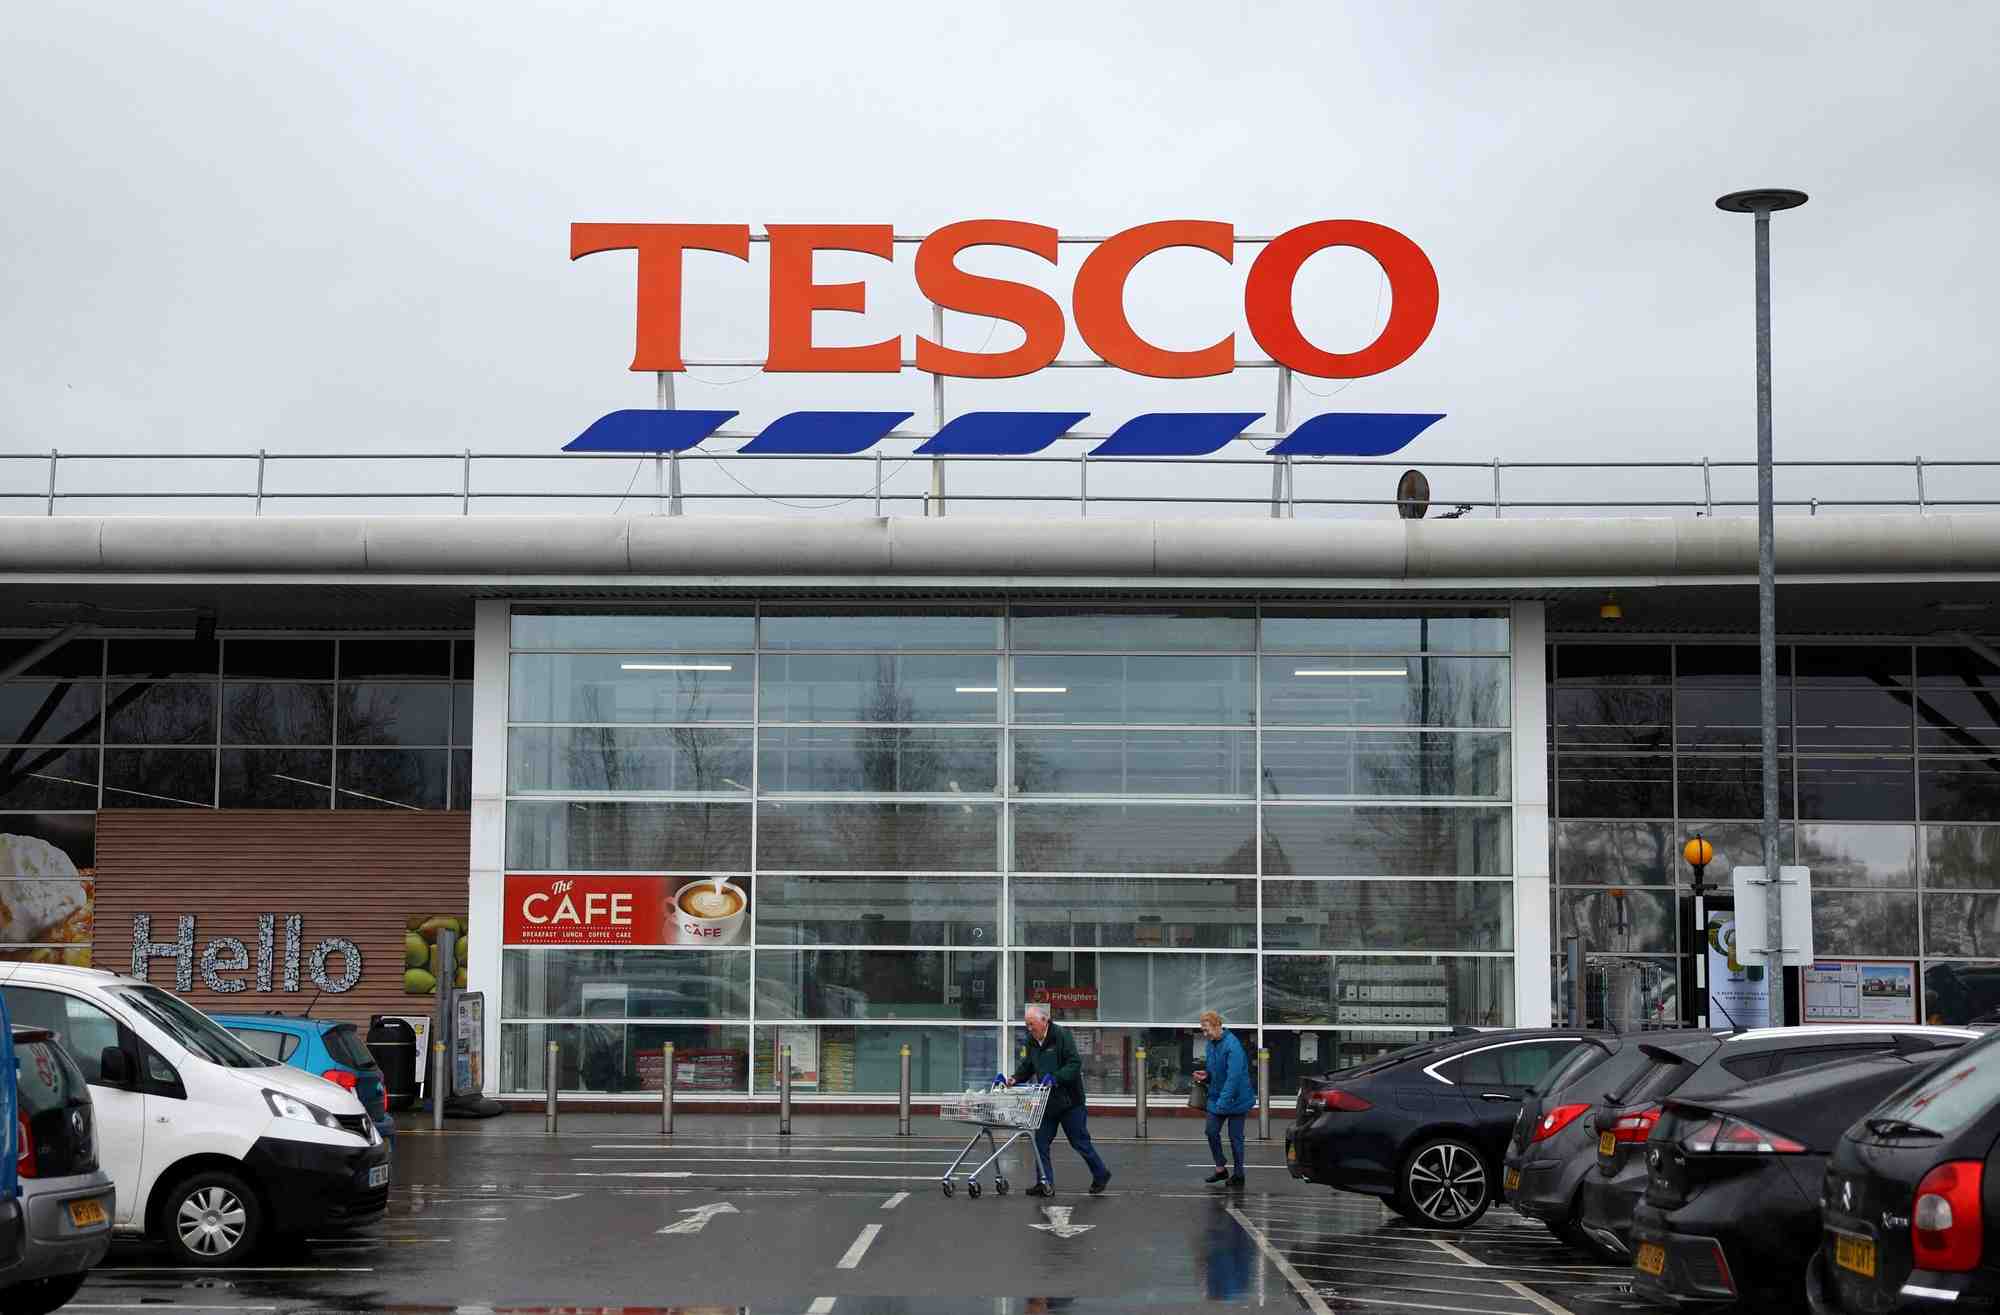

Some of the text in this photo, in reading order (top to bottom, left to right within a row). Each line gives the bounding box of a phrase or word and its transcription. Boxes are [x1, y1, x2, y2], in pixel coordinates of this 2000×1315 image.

[570, 219, 1439, 378] TESCO
[522, 892, 633, 925] CAFE
[551, 880, 574, 895] The
[131, 912, 363, 994] Hello
